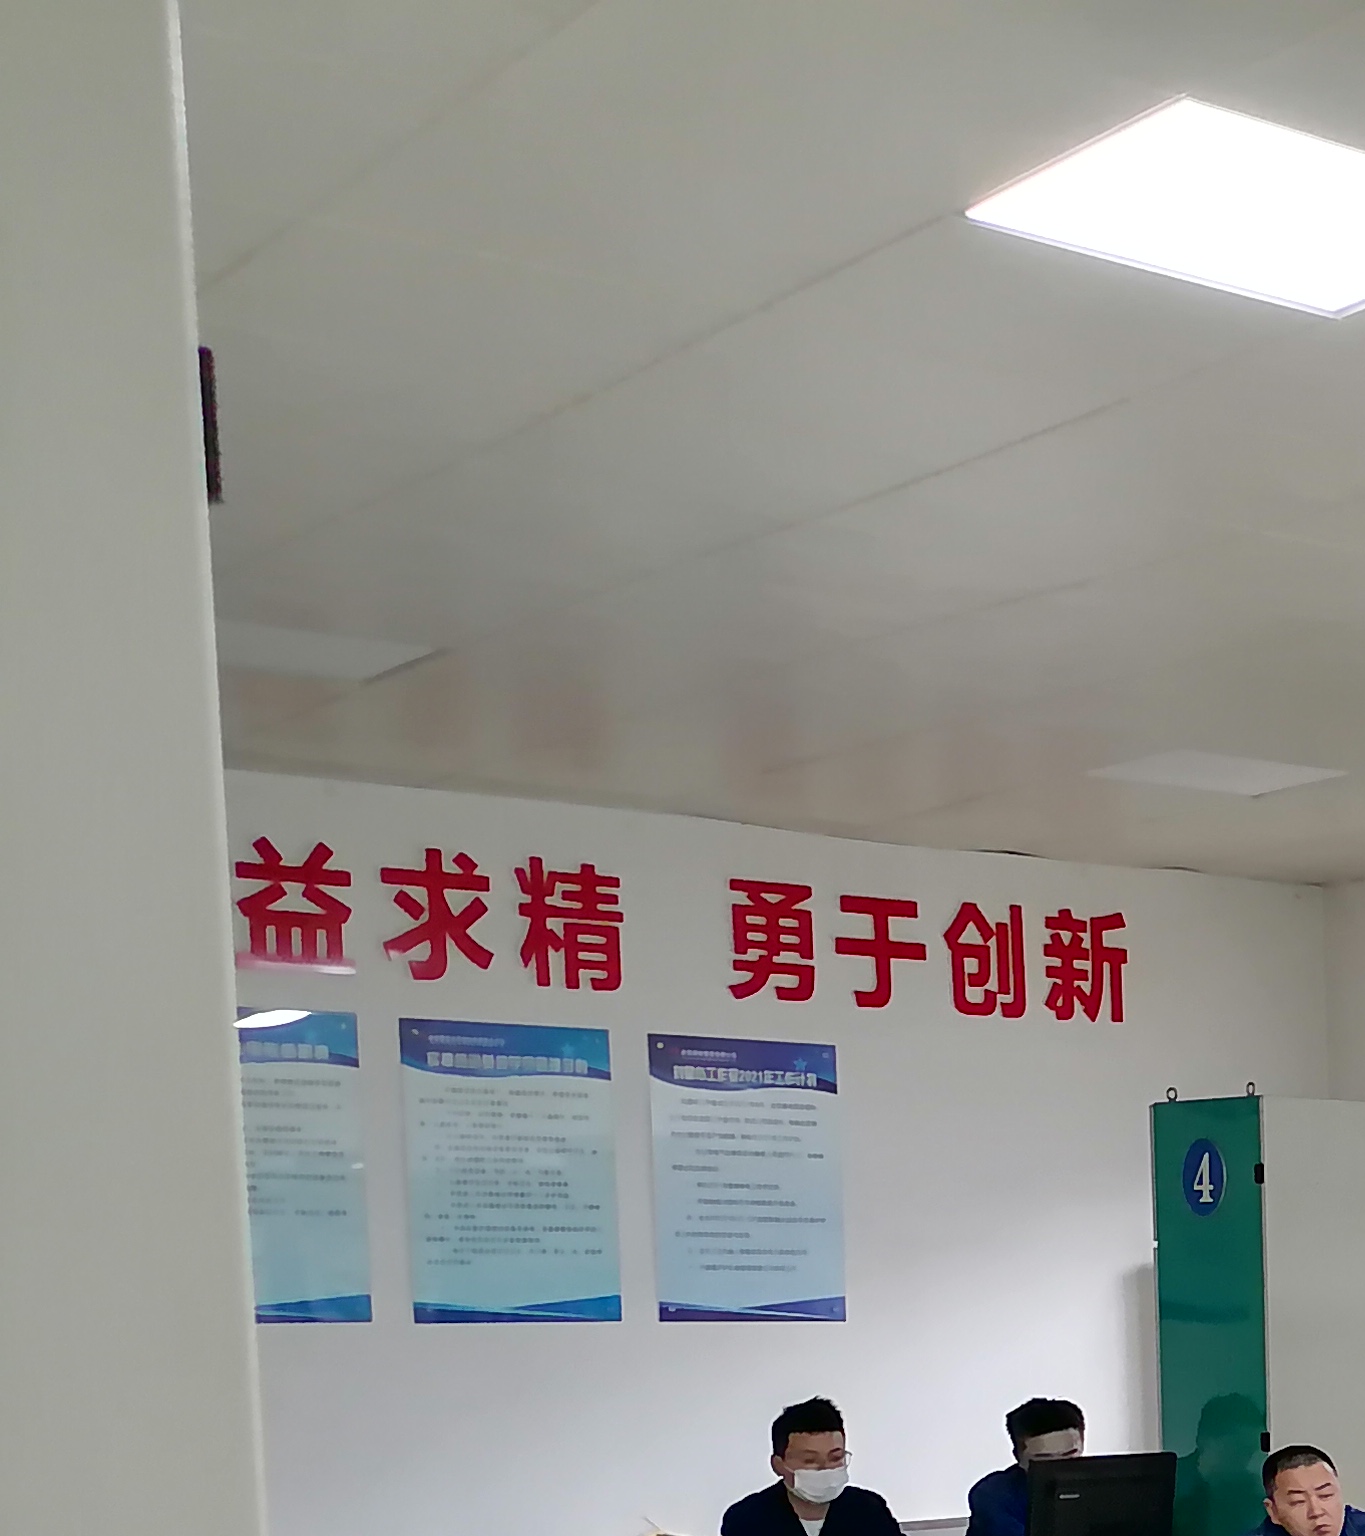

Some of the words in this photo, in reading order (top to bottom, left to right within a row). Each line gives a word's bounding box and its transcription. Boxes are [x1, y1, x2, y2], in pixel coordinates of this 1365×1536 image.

[235, 836, 624, 991] 益求精
[728, 878, 1128, 1023] 勇于创新
[1193, 1151, 1214, 1203] 4
